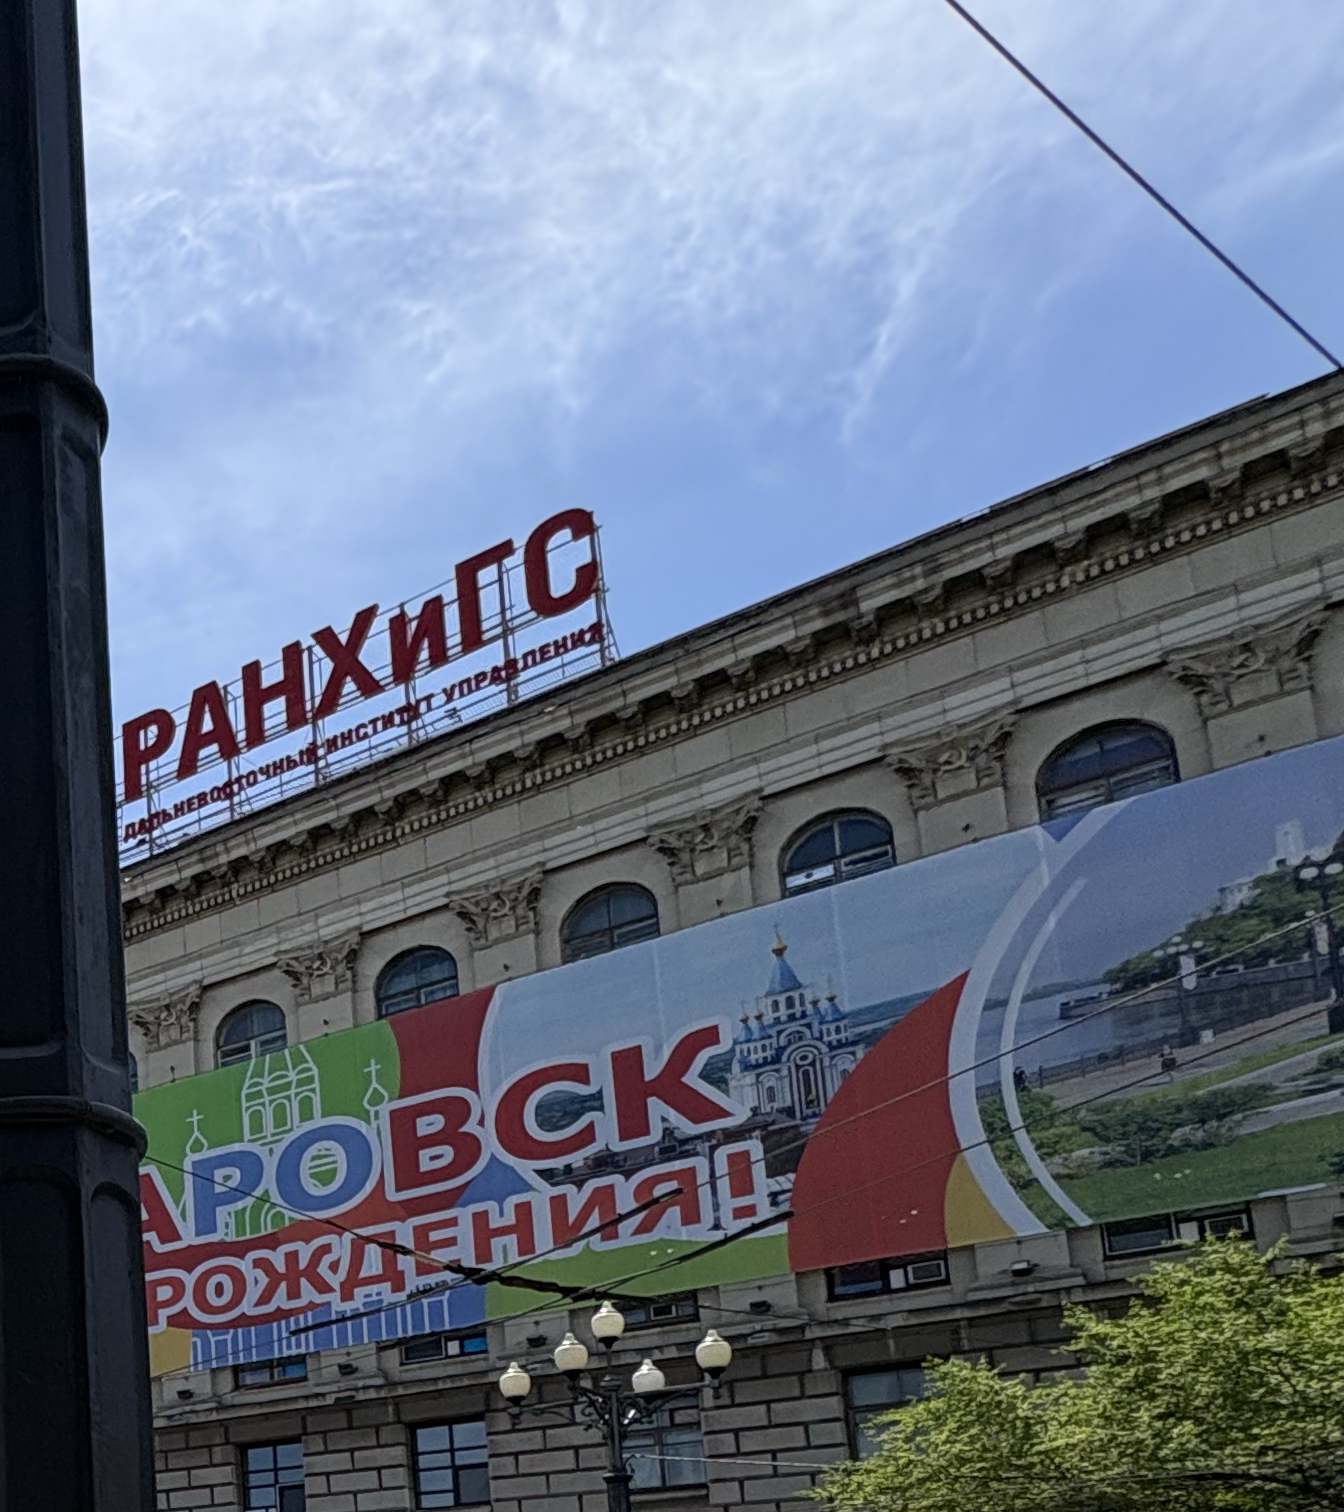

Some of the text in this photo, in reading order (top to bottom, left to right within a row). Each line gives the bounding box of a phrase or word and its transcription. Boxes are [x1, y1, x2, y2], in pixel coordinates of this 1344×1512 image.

[121, 507, 599, 803] РАНХиГС
[123, 619, 605, 844] ДАЛЬНЕВОСТОЧНЫЙ ИНСТИТУТ УПРАВЛЕНИЯ
[148, 1149, 758, 1327] РОЖДЕНИЯ!
